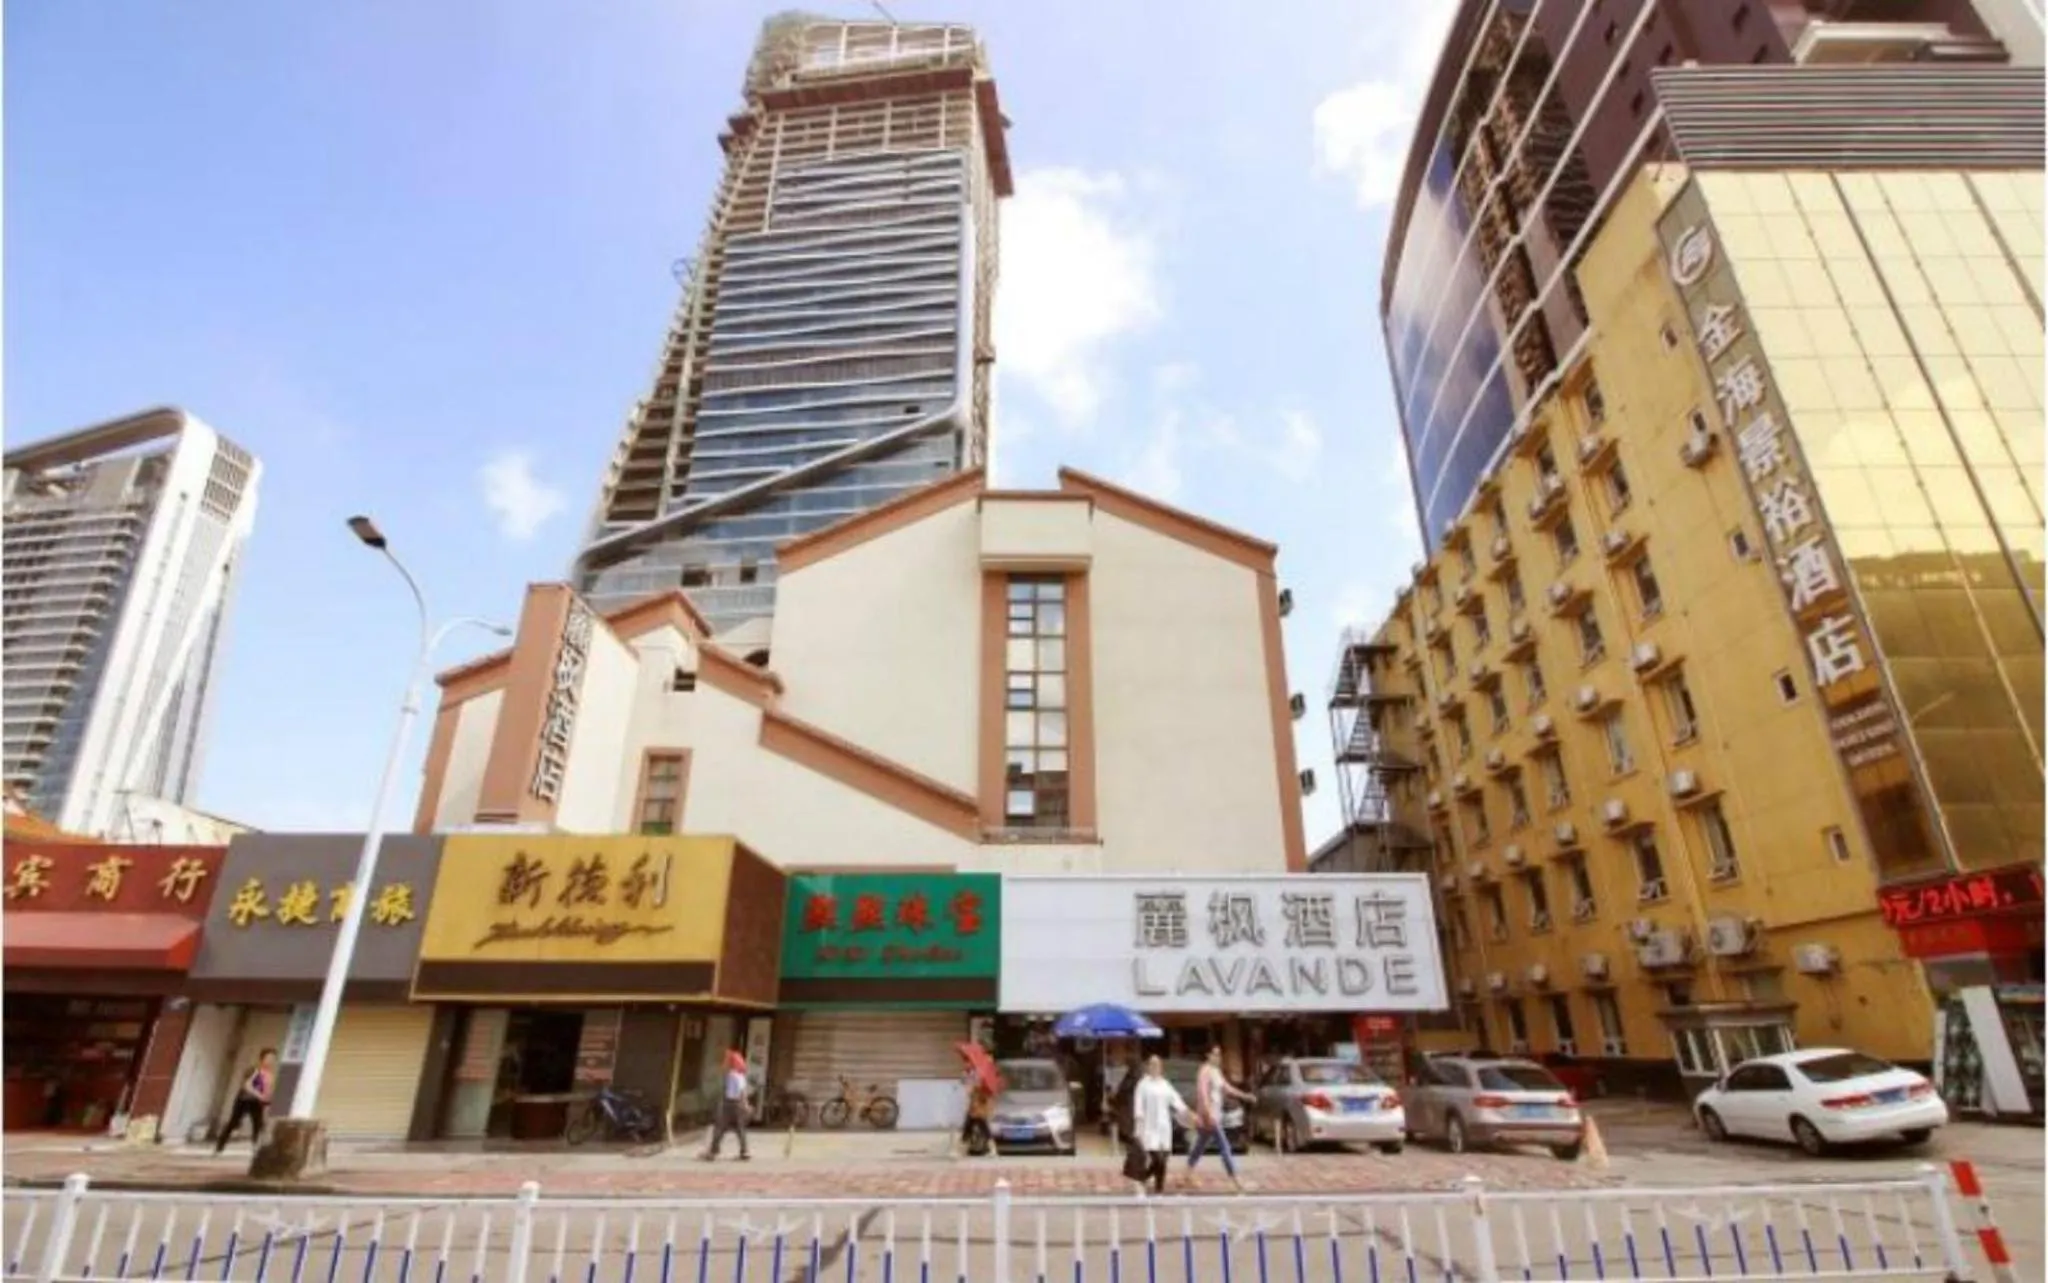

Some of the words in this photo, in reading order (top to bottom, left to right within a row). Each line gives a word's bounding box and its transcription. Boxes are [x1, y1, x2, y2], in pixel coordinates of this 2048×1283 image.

[1697, 303, 1867, 687] 金海景裕酒店
[1132, 955, 1419, 997] LAVANDE
